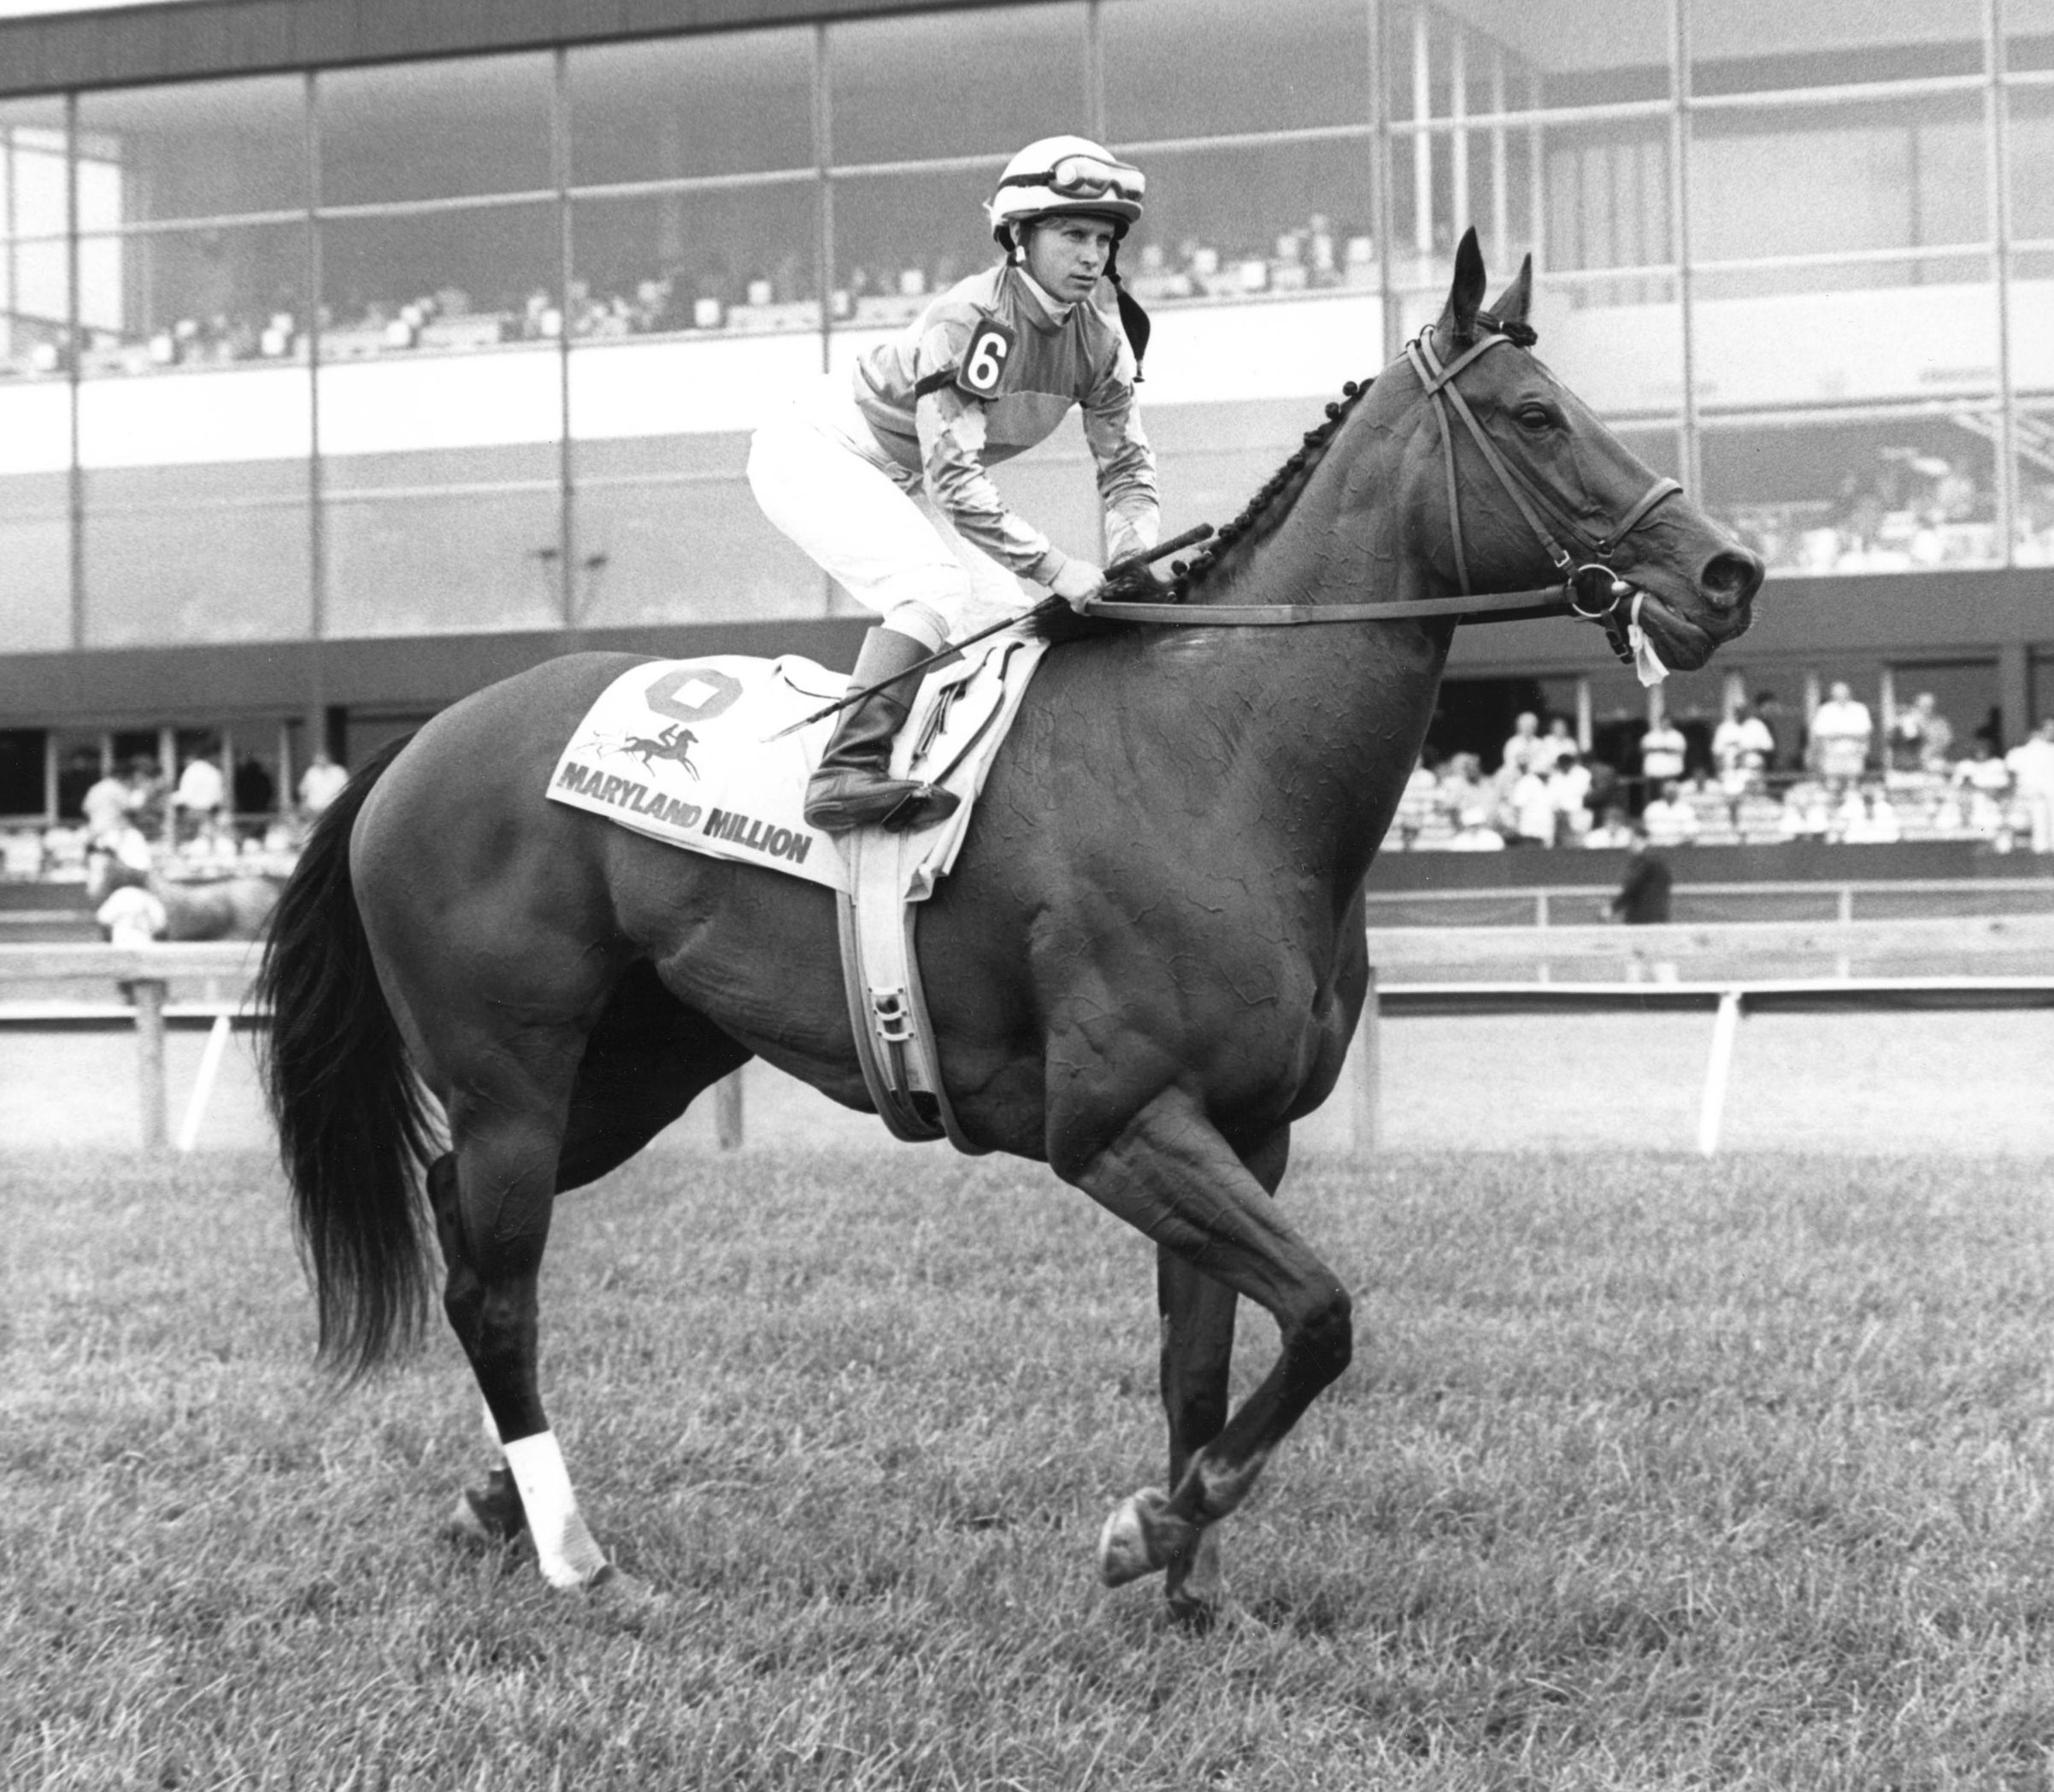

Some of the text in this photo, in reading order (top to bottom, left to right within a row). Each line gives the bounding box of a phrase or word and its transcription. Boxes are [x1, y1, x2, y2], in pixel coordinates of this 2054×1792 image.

[968, 332, 1007, 389] 6
[556, 761, 812, 864] MARYLAND MILLION
